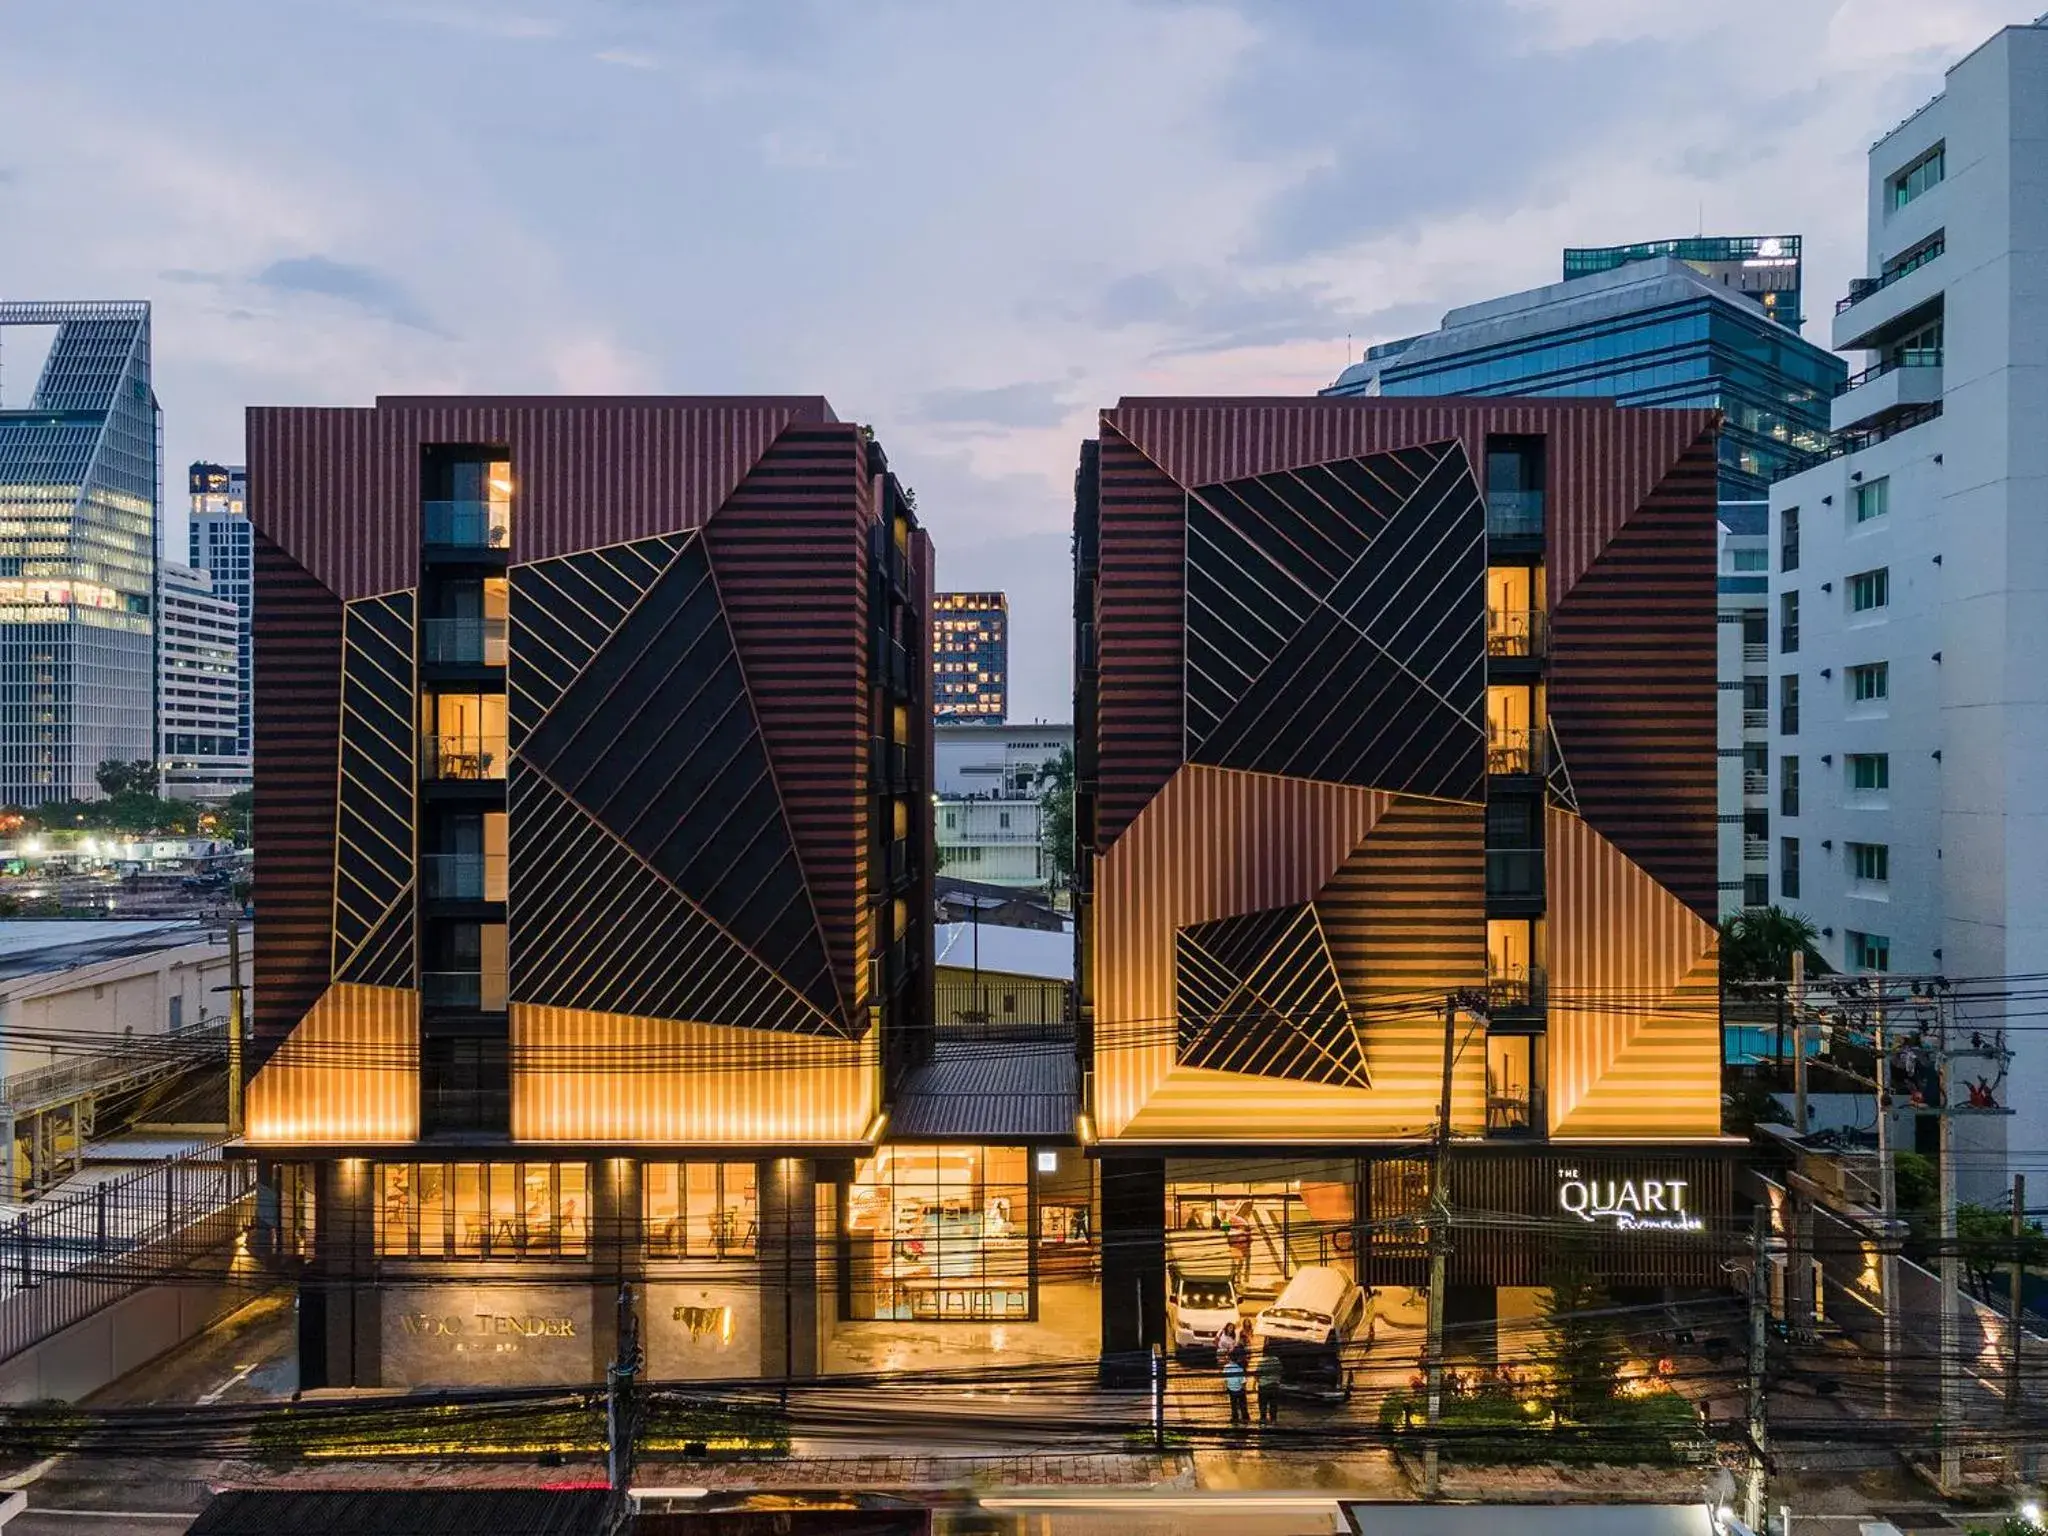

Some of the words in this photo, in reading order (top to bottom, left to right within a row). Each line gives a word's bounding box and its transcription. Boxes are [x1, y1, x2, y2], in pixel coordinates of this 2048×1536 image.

[1558, 1169, 1579, 1178] THE
[1560, 1180, 1689, 1221] QUART
[474, 1313, 576, 1337] TENDER
